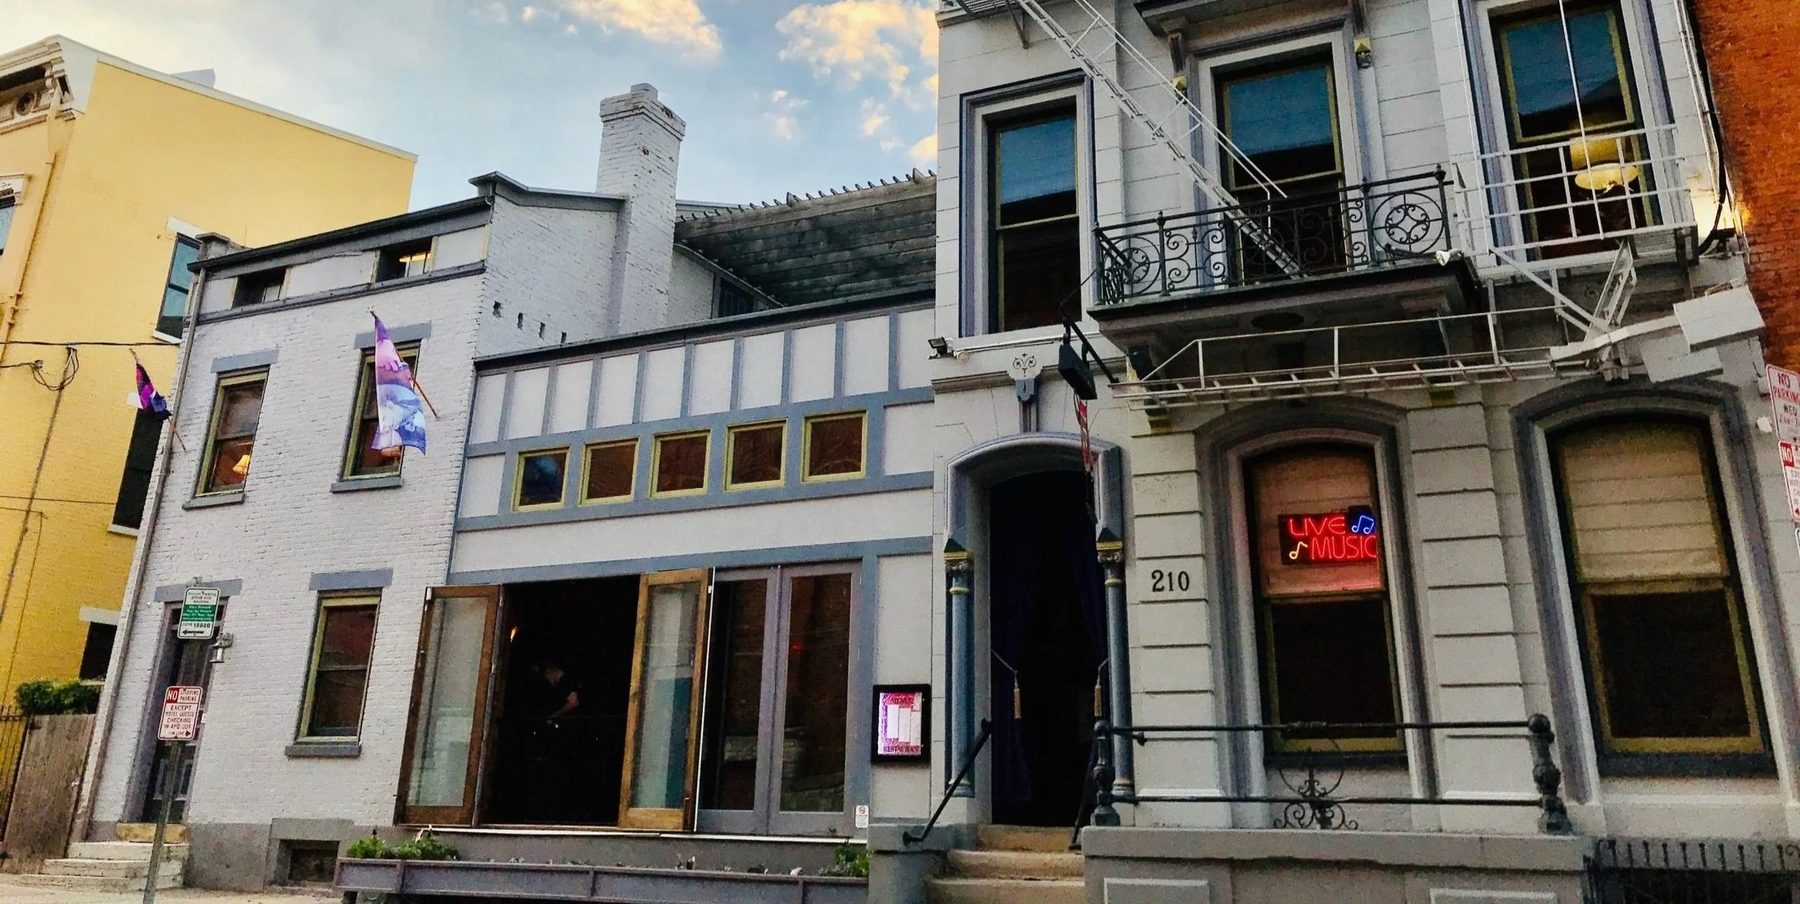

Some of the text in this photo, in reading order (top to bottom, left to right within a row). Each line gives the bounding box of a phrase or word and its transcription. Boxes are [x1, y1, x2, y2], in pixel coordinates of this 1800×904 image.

[1778, 371, 1791, 389] NO
[1289, 516, 1346, 536] LIVE
[1311, 535, 1378, 560] MUSIC
[1151, 569, 1190, 592] 210
[167, 690, 178, 701] NO
